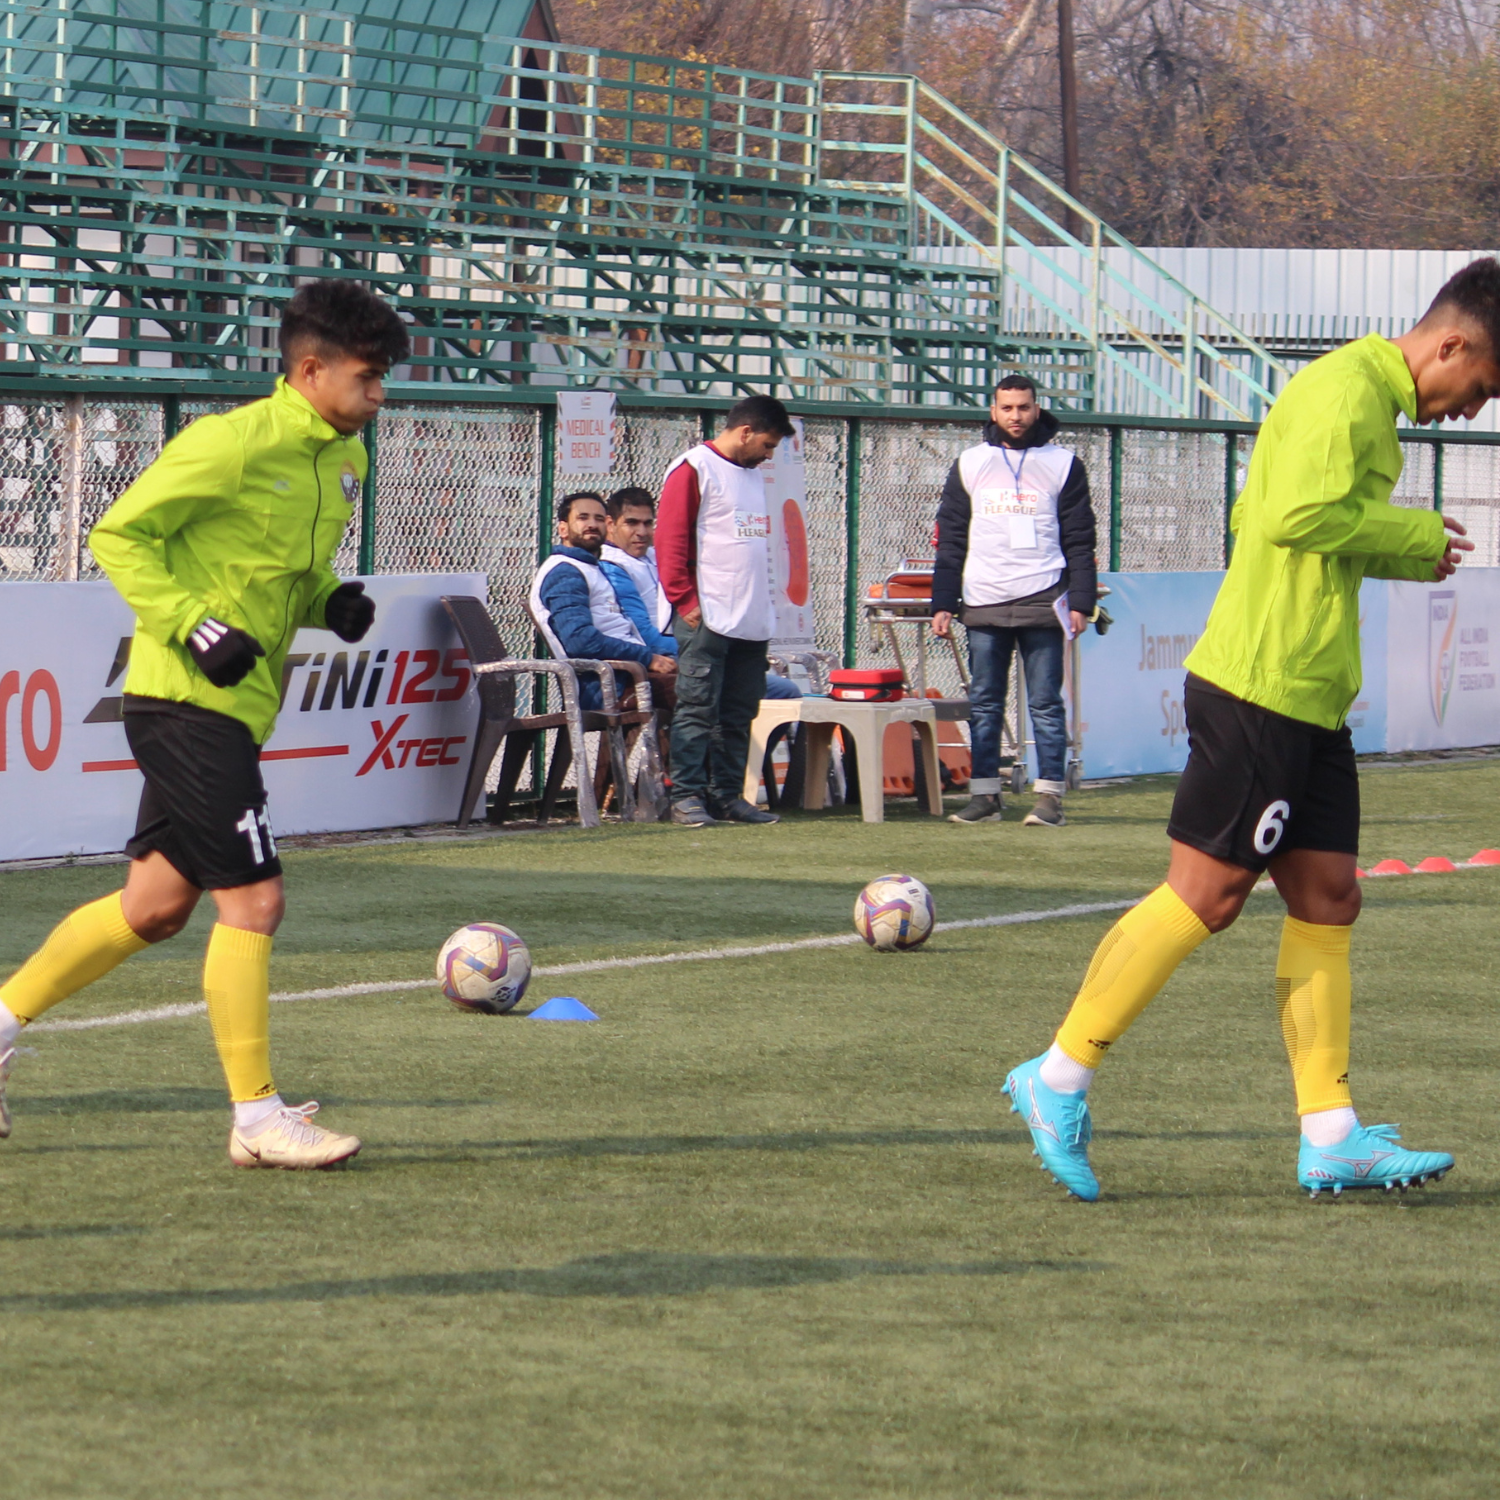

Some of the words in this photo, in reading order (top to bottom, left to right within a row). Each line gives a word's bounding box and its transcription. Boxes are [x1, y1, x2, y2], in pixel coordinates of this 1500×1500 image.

[566, 419, 606, 436] MEDICAL
[571, 442, 601, 459] BENCH
[237, 804, 278, 865] 11
[1254, 799, 1290, 854] 6
